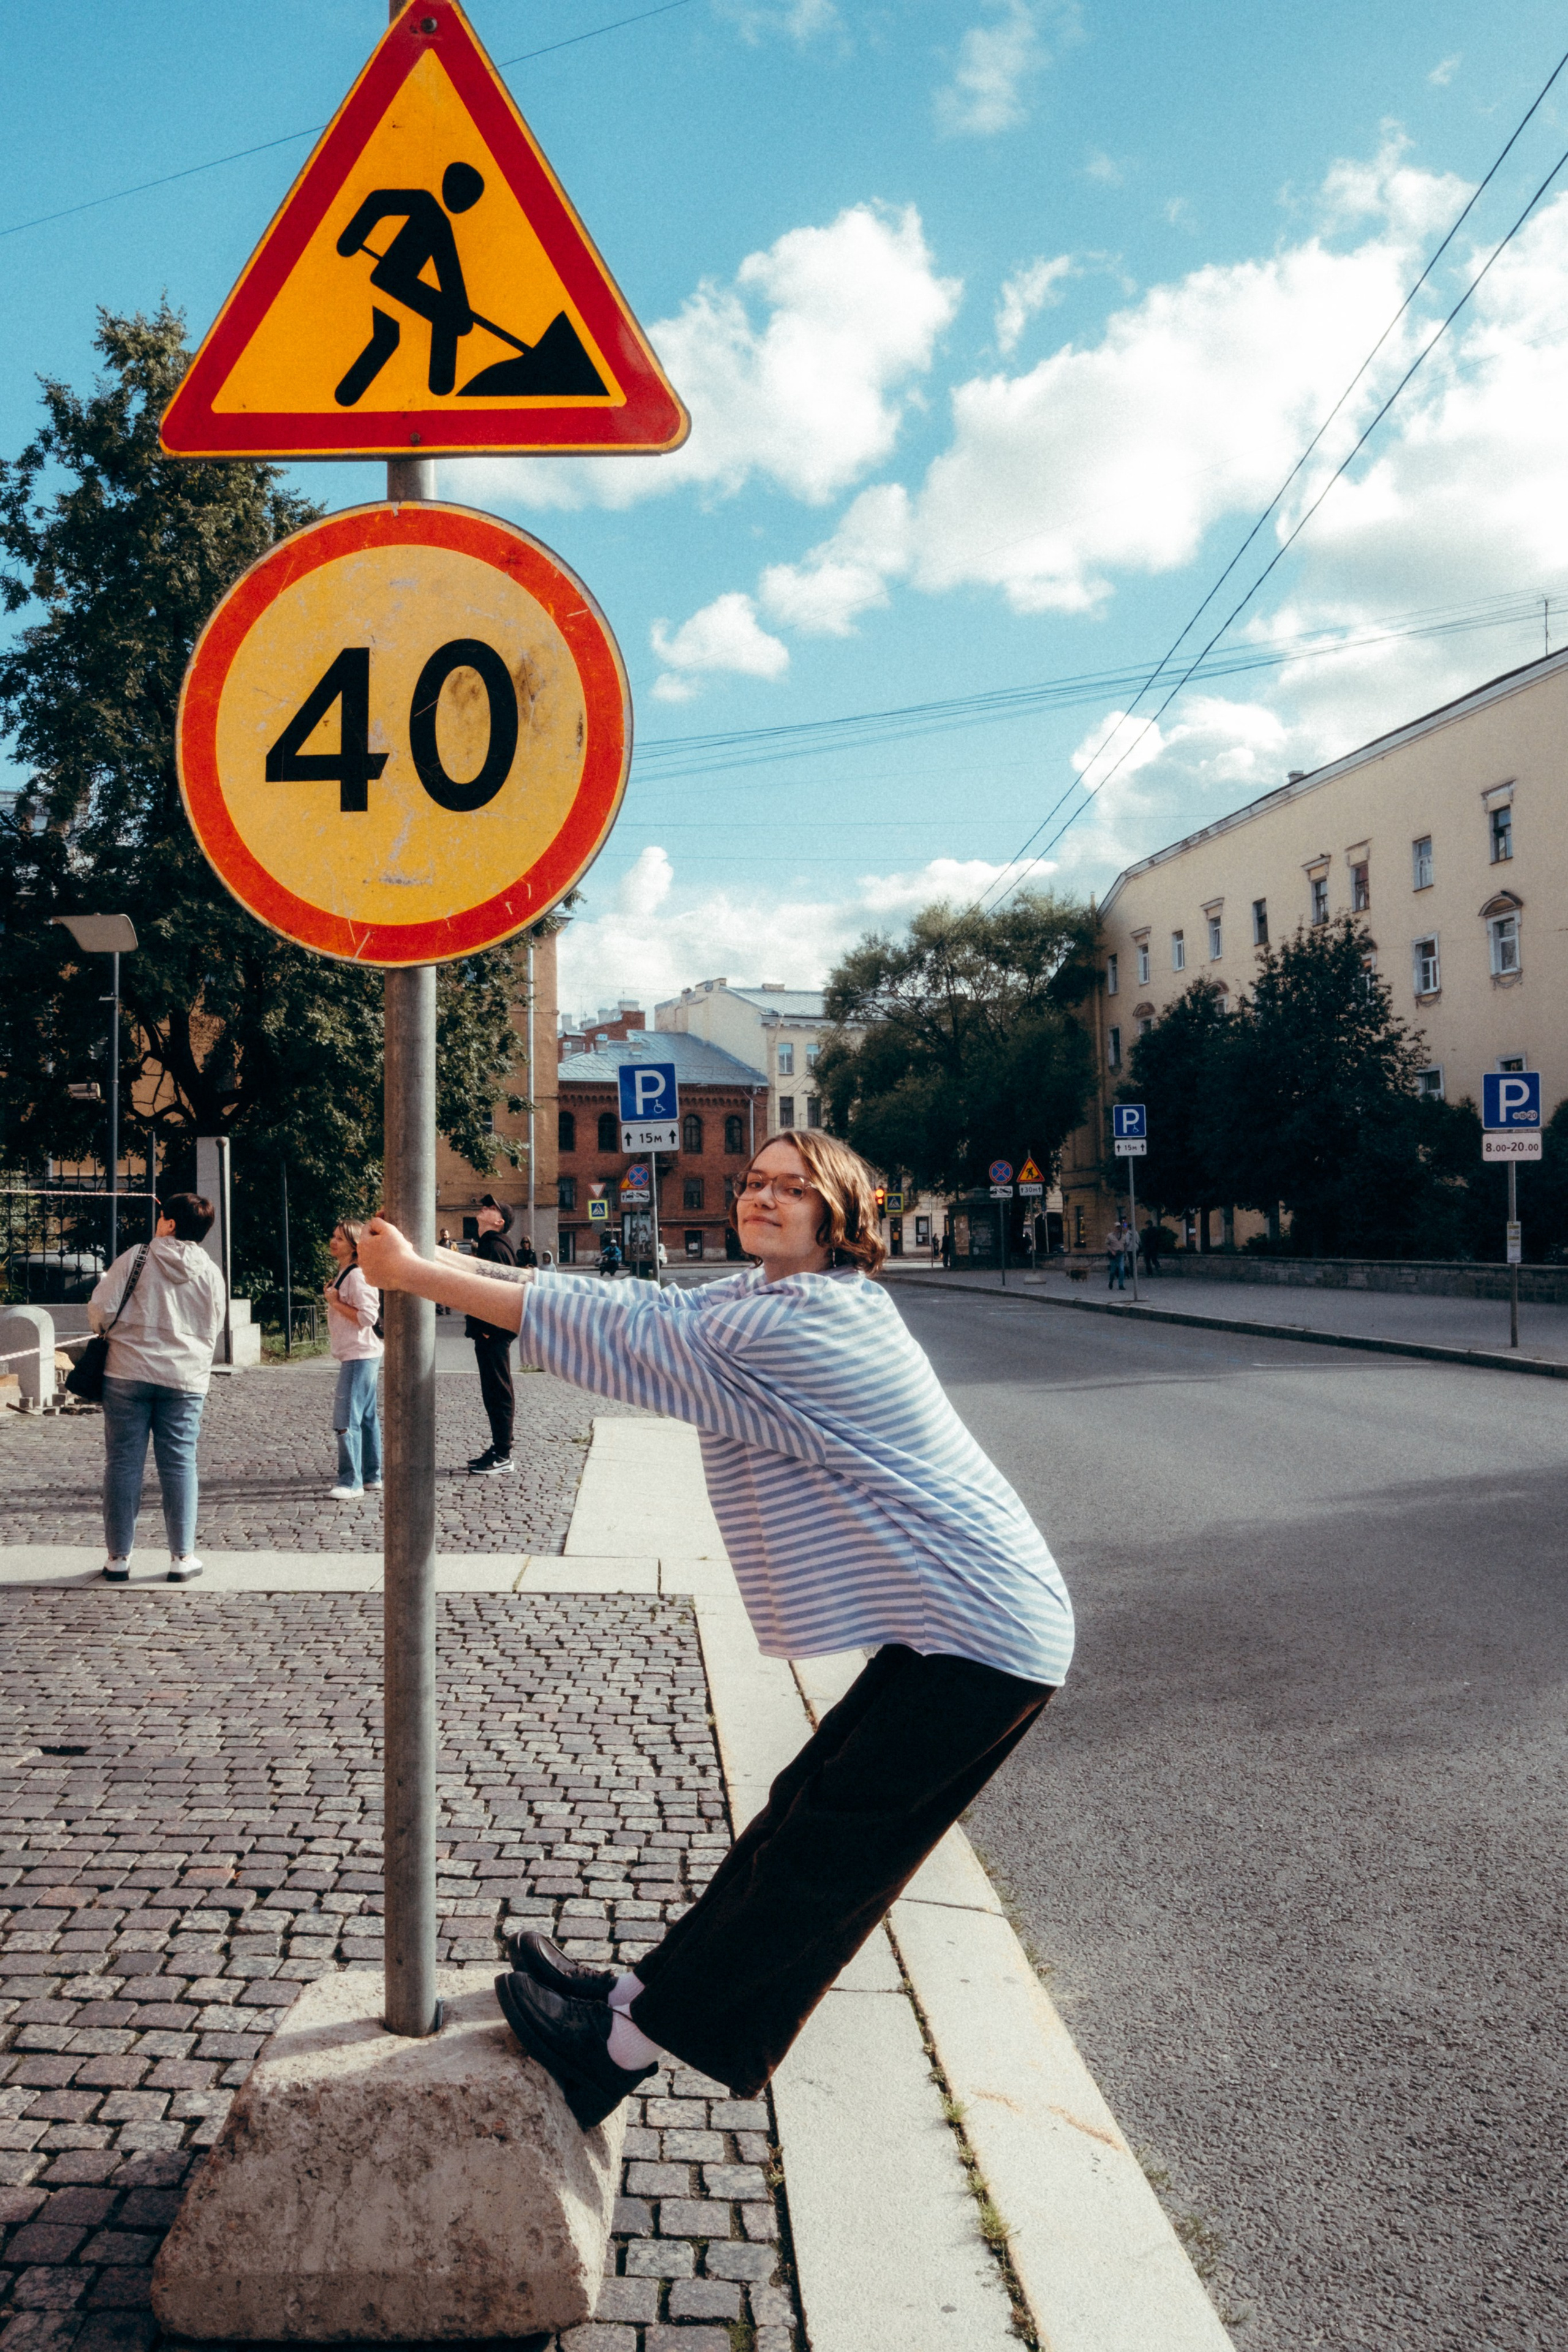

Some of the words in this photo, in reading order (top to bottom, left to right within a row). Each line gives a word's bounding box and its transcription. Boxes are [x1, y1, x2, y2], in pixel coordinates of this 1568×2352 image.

[265, 638, 519, 813] 40
[635, 1069, 666, 1115] P
[1499, 1079, 1530, 1123] P
[1123, 1109, 1139, 1133] P
[1485, 1142, 1539, 1152] 8.00-20.00
